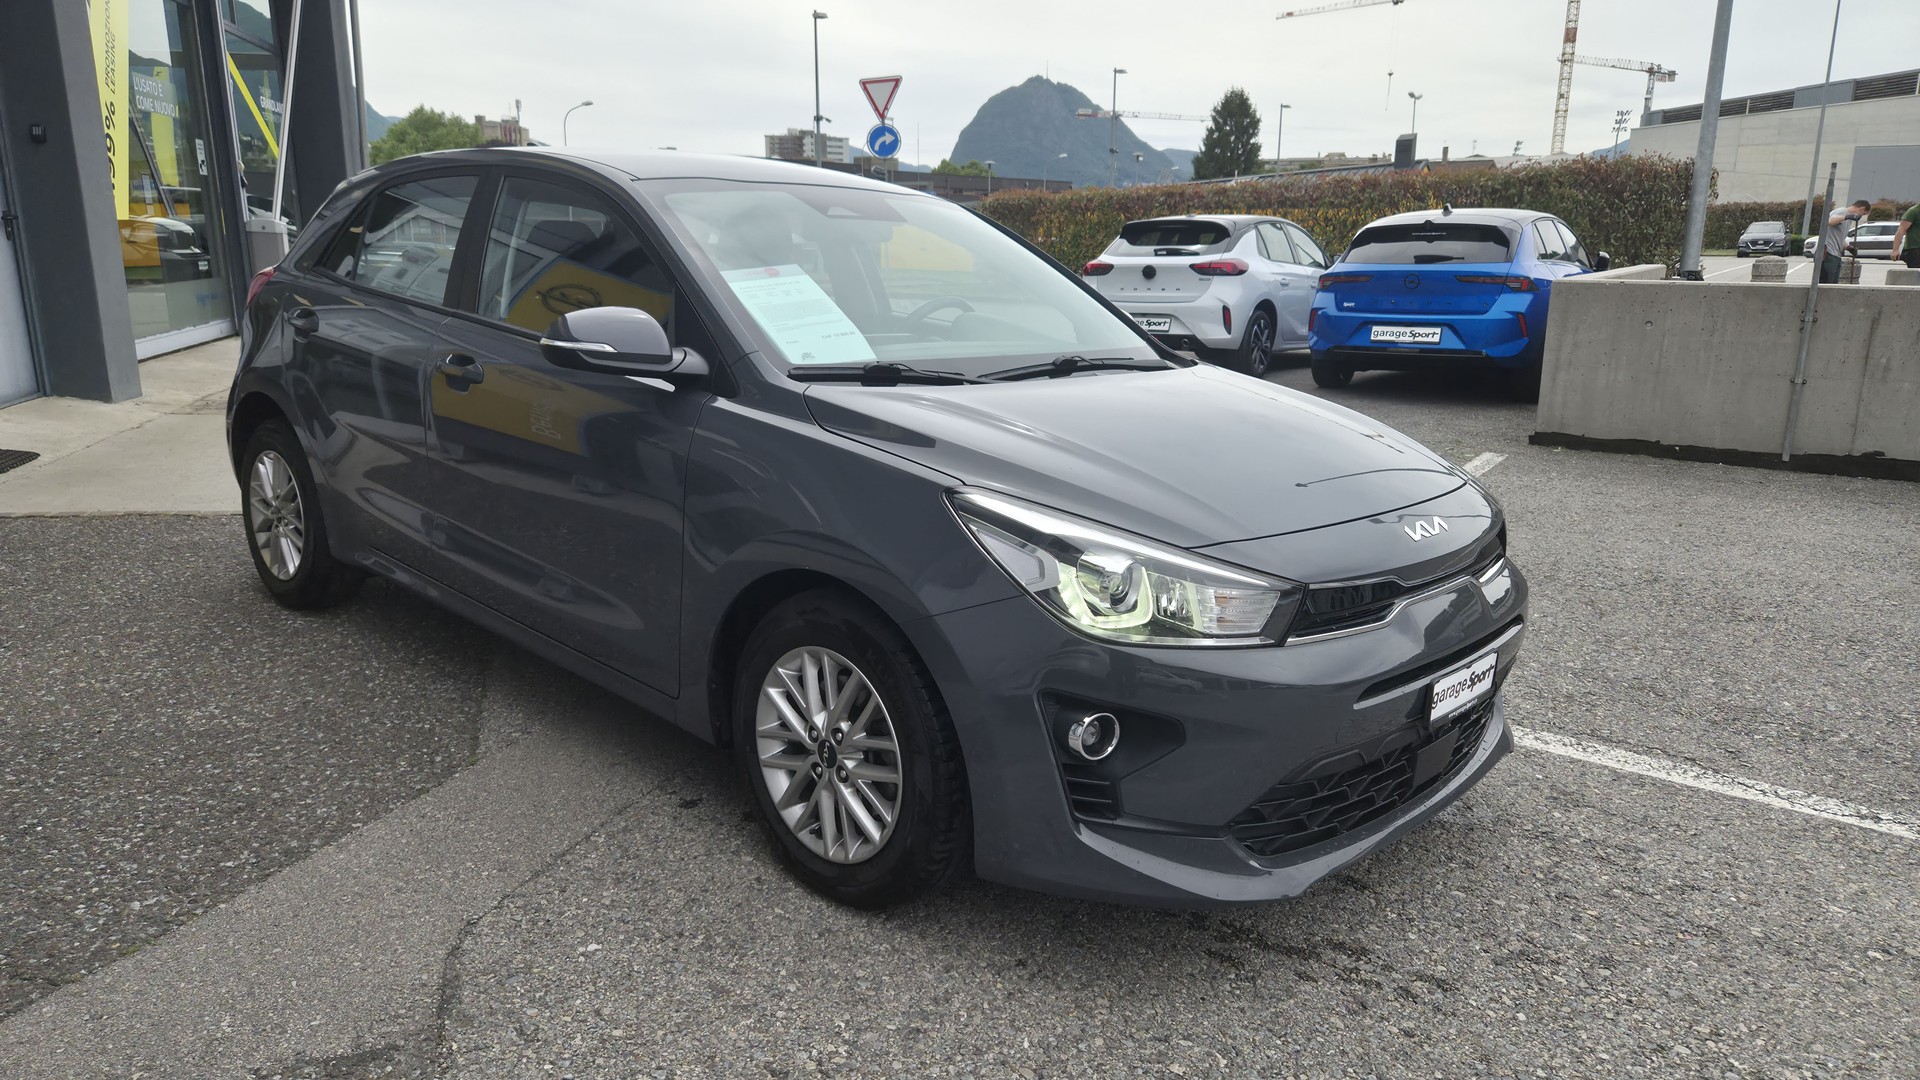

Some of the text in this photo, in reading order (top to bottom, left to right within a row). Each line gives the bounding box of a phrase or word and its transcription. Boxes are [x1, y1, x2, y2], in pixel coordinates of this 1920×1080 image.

[133, 76, 158, 95] L'USATO
[136, 95, 176, 117] COME NUOVO
